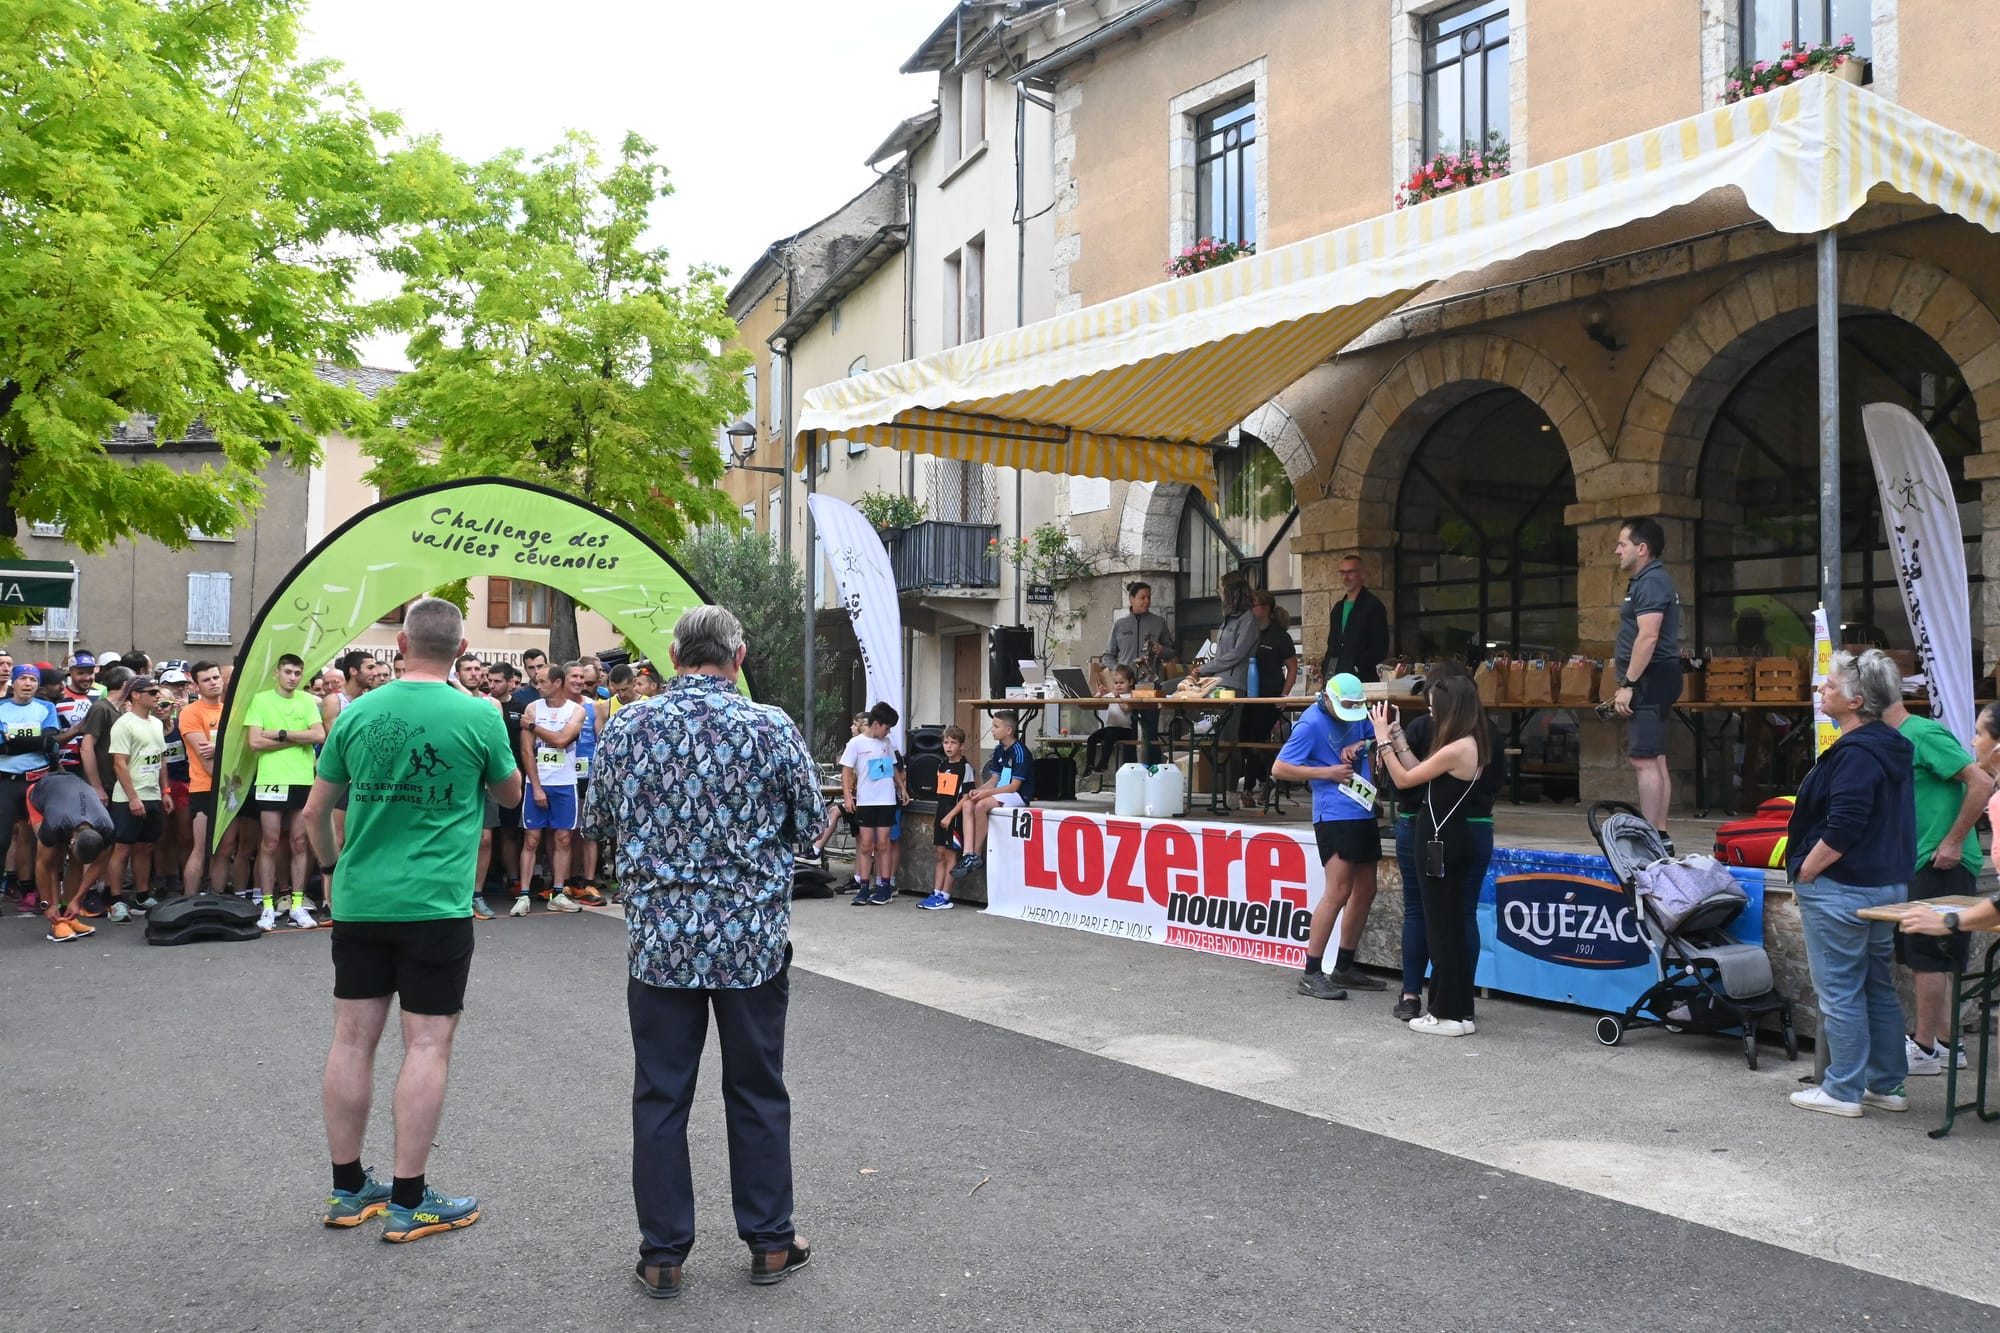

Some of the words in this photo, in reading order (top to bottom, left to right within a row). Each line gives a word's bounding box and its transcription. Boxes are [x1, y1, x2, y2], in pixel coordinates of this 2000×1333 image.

[431, 507, 553, 548] Challenge
[568, 532, 610, 548] des
[412, 530, 500, 558] vallées
[514, 548, 620, 570] cévenoles
[17, 728, 33, 737] 88
[543, 753, 558, 763] 64
[878, 764, 885, 773] 1
[263, 784, 280, 794] 74
[356, 782, 372, 791] LES
[374, 782, 424, 793] SENTIERS
[1350, 779, 1372, 799] 117
[355, 794, 369, 803] DE
[370, 794, 385, 803] LA
[386, 795, 423, 805] FRAISE
[1011, 808, 1032, 839] La
[1167, 892, 1313, 942] nouvelle
[1503, 891, 1639, 946] QUÉZAC
[1079, 914, 1109, 932] PARLE
[1109, 919, 1125, 935] DE
[1126, 922, 1153, 940] VOUS
[1575, 943, 1595, 955] 1901
[412, 1211, 440, 1224] HOKA
